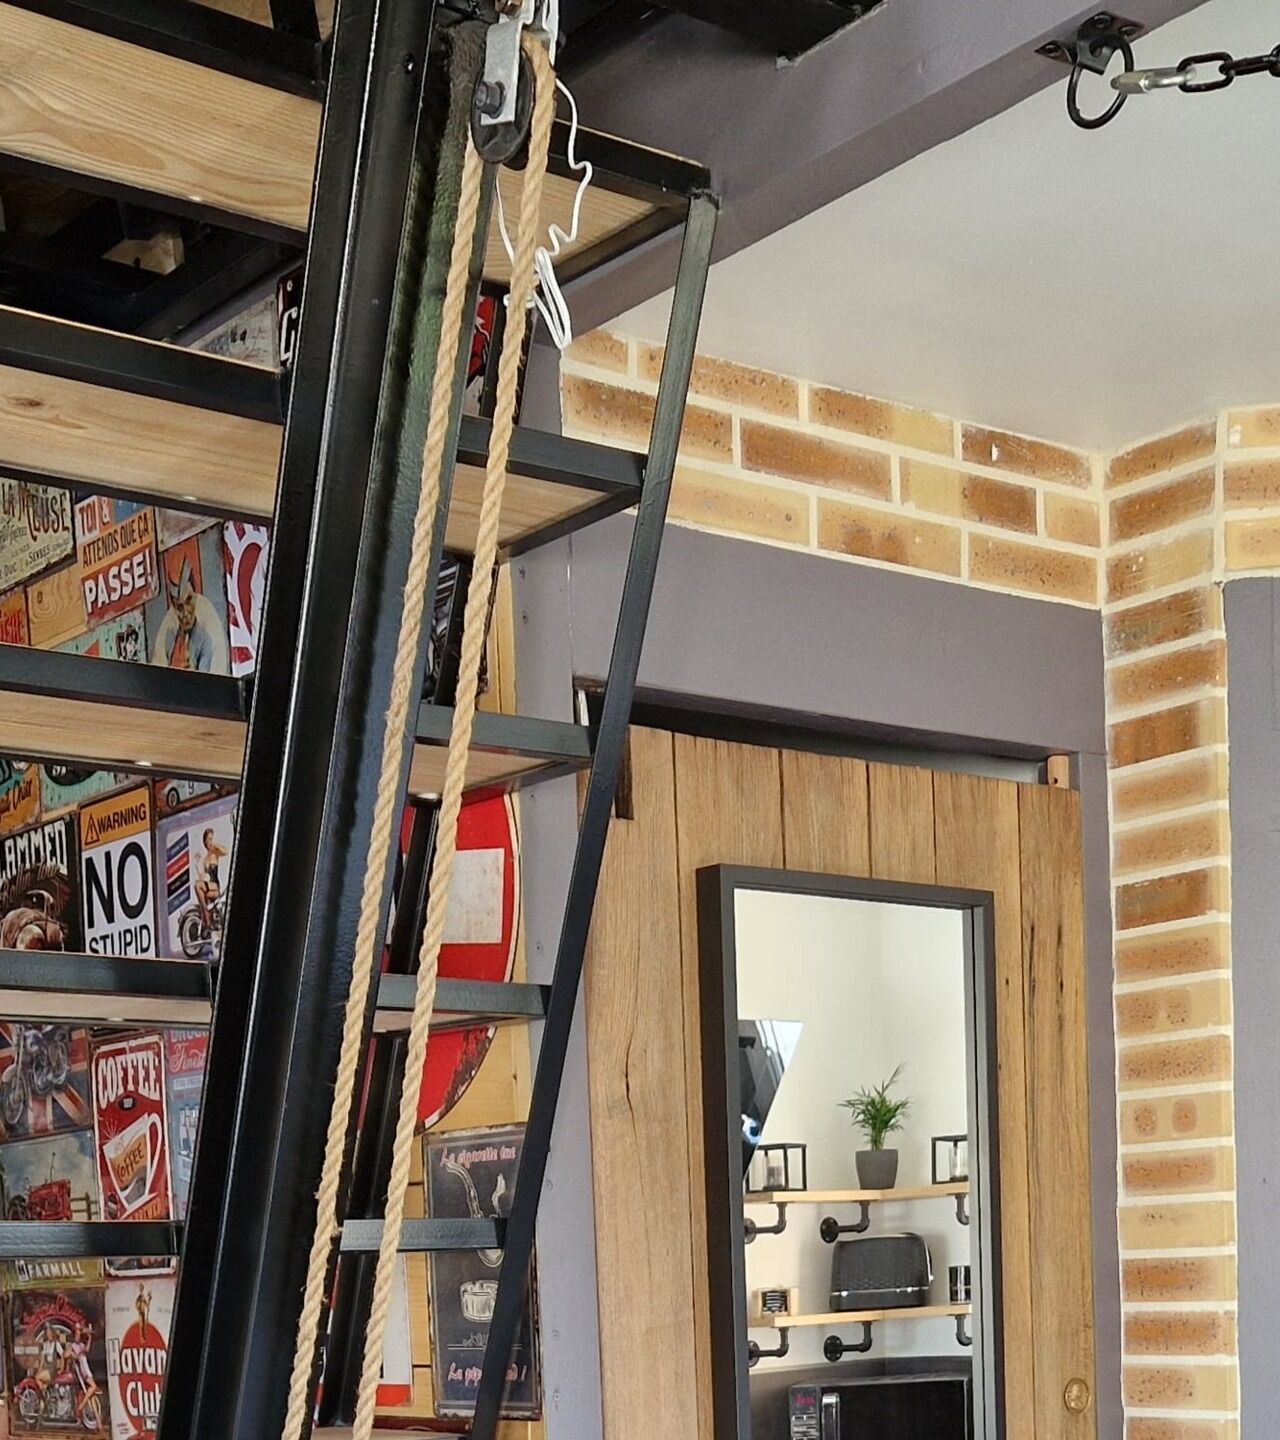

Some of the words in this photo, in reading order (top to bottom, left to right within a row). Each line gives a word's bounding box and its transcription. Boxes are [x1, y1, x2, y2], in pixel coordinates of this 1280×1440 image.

[78, 499, 98, 537] TOI
[101, 497, 111, 525] &
[82, 527, 119, 568] ATTENDS
[120, 520, 137, 549] QUE
[137, 513, 151, 545] ÇA
[84, 547, 153, 614] PASSE!
[96, 802, 148, 835] WARNING
[85, 841, 149, 929] NO
[89, 923, 152, 957] STUPID
[97, 1050, 161, 1110] COFFEE
[28, 1260, 86, 1279] FARMALL
